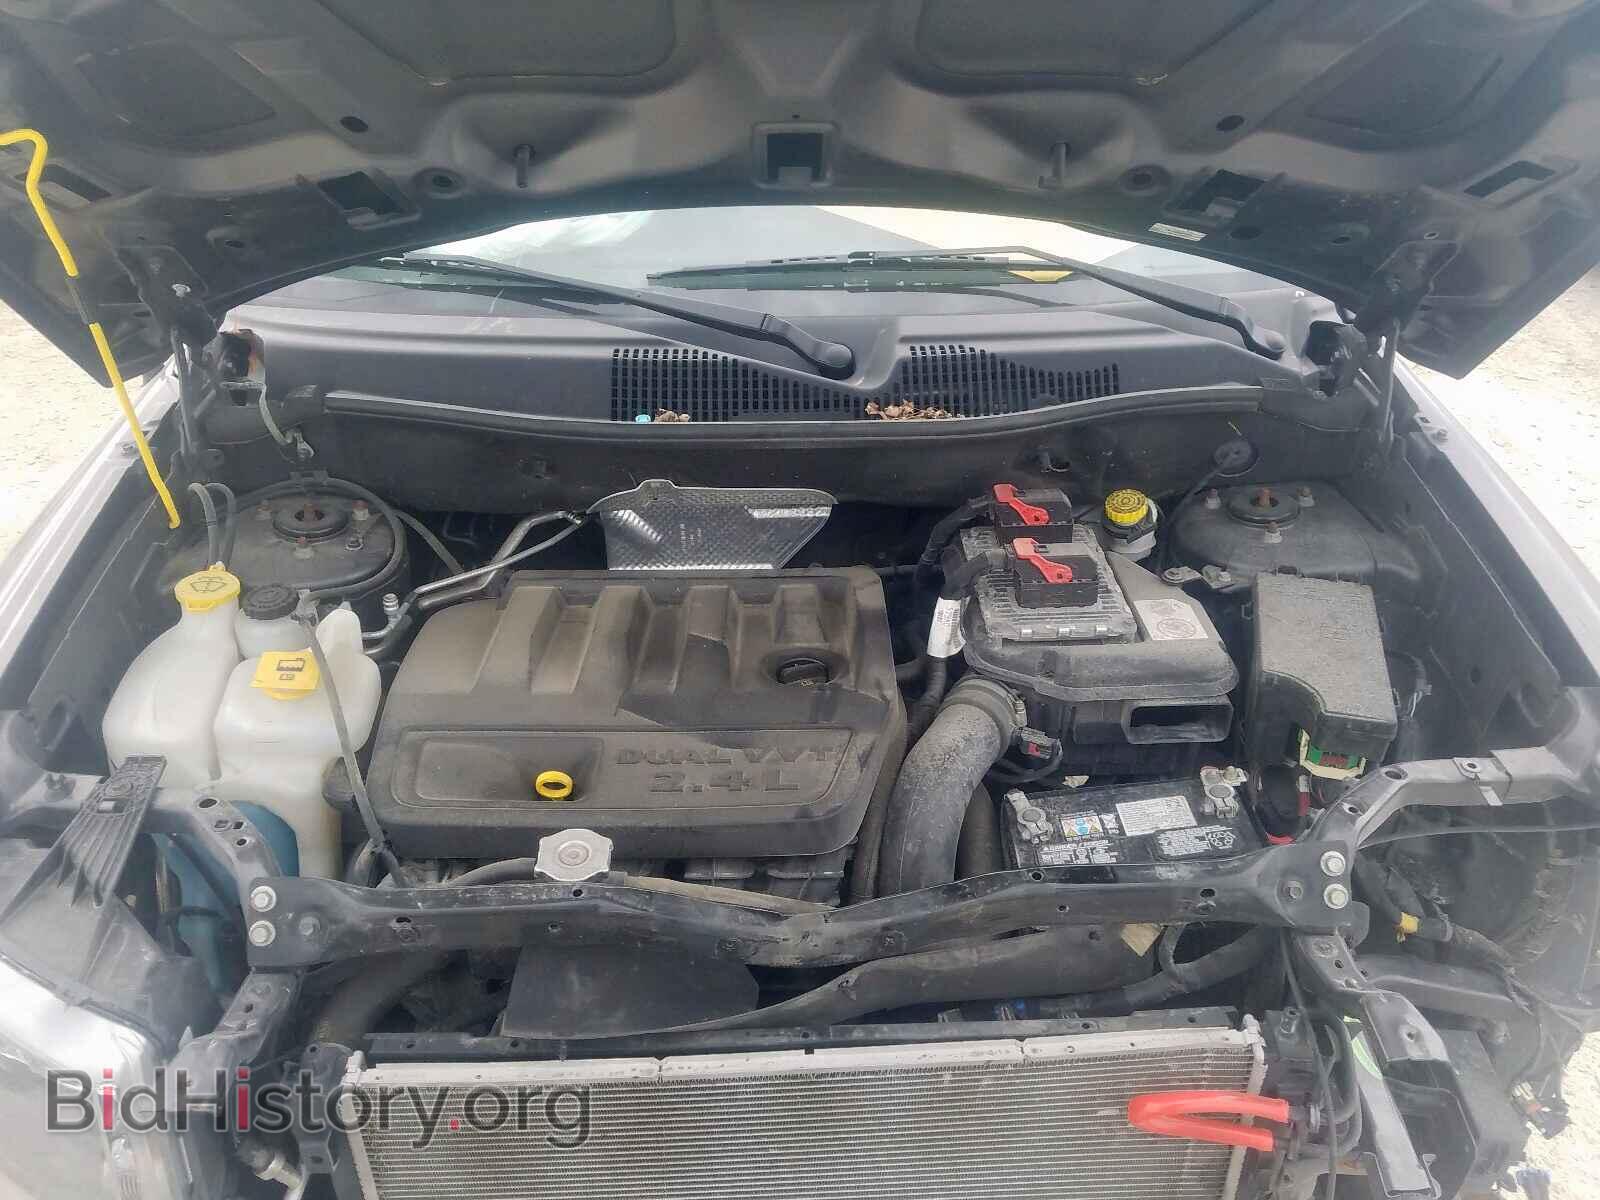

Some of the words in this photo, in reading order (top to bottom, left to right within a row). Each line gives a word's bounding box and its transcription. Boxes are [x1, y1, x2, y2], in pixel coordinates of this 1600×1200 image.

[615, 748, 732, 766] DUAL
[742, 748, 837, 764] VVT
[648, 768, 799, 793] 2.4L
